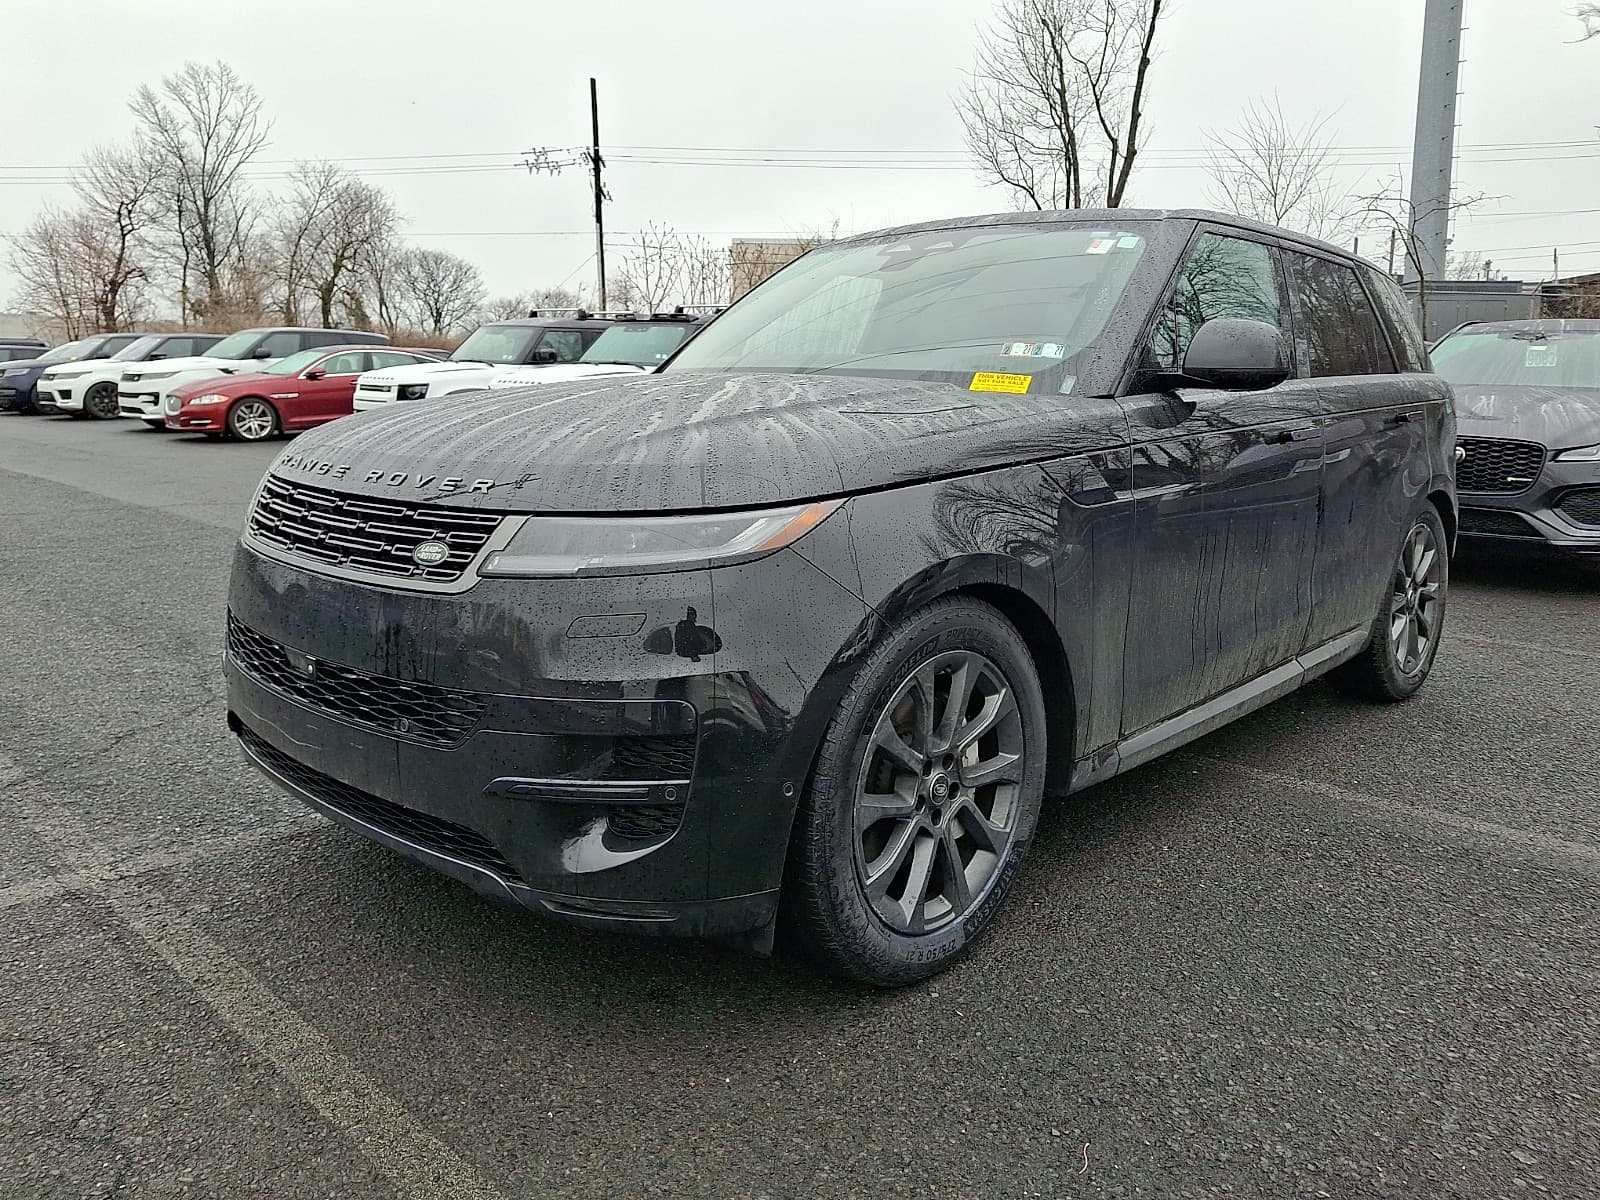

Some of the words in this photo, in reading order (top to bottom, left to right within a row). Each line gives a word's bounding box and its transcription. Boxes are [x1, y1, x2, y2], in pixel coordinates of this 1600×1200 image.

[996, 374, 1030, 382] VEHICLE
[280, 454, 350, 479] RANGE
[363, 469, 495, 495] ROVER
[419, 545, 442, 553] LAND
[417, 552, 442, 560] ROVER
